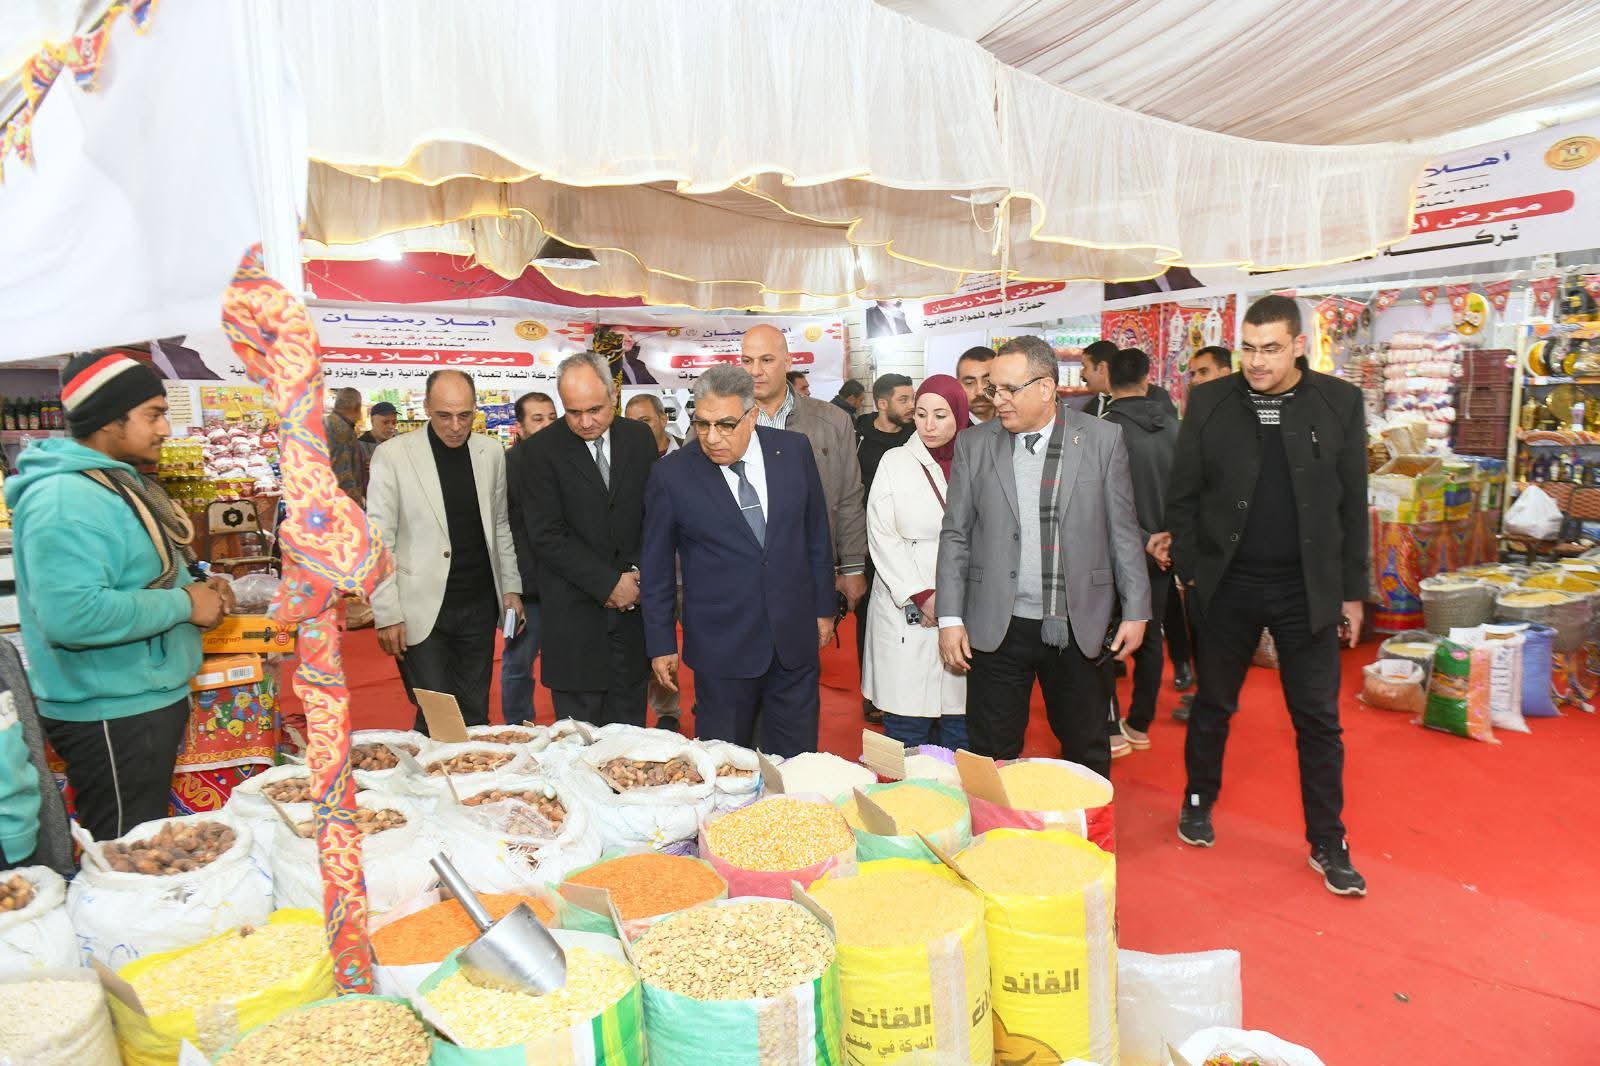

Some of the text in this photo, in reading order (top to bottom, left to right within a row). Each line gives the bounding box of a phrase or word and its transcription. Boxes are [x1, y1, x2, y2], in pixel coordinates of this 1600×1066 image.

[1436, 201, 1543, 229] معرض
[1010, 282, 1055, 299] معرض
[931, 299, 973, 314] رمضان
[1018, 300, 1046, 313] حمزة
[322, 313, 426, 326] رمضان
[321, 350, 374, 362] رمض
[446, 353, 515, 365] معرض
[360, 367, 394, 379] وشركة
[531, 370, 558, 381] شركة
[877, 1040, 896, 1060] في
